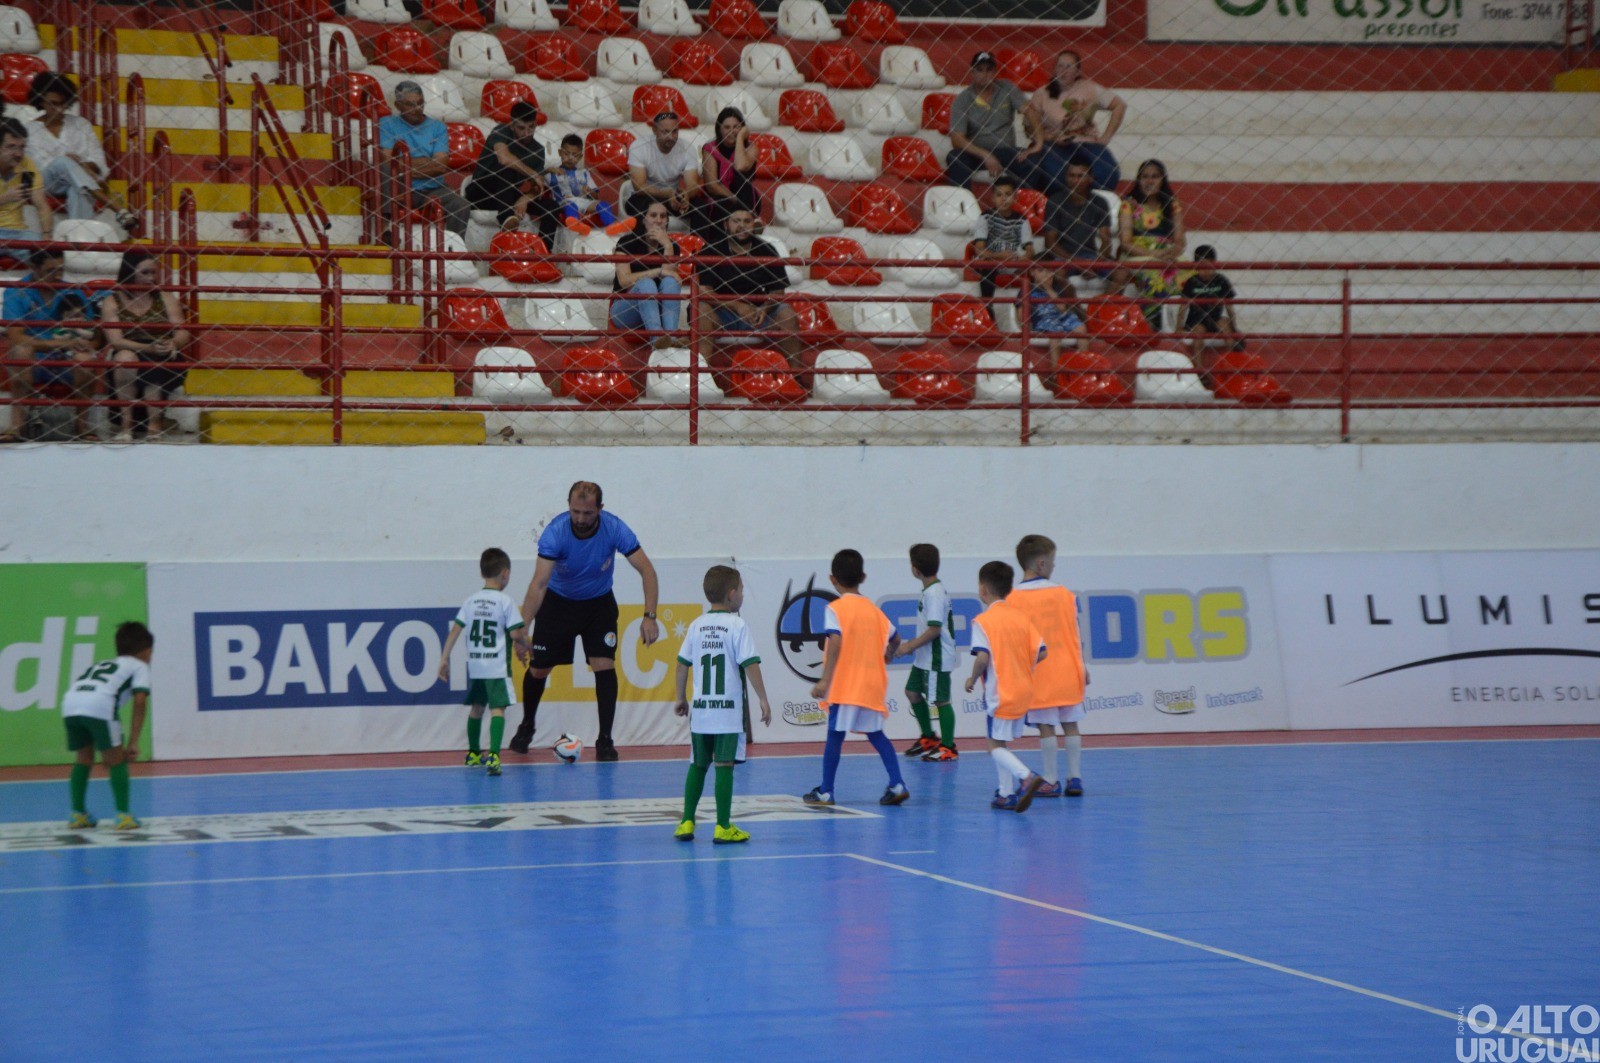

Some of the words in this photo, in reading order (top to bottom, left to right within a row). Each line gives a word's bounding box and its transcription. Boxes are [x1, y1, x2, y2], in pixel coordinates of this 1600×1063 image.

[1365, 21, 1460, 39] presentes
[469, 619, 498, 648] 45
[701, 654, 725, 695] 11
[1086, 692, 1145, 713] Internet
[1154, 686, 1197, 706] Speed
[1207, 687, 1265, 709] Internet
[1452, 686, 1546, 702] ENERGIA
[708, 700, 735, 709] TAYLOR
[783, 701, 825, 718] Spee
[1168, 699, 1197, 712] FIBRA
